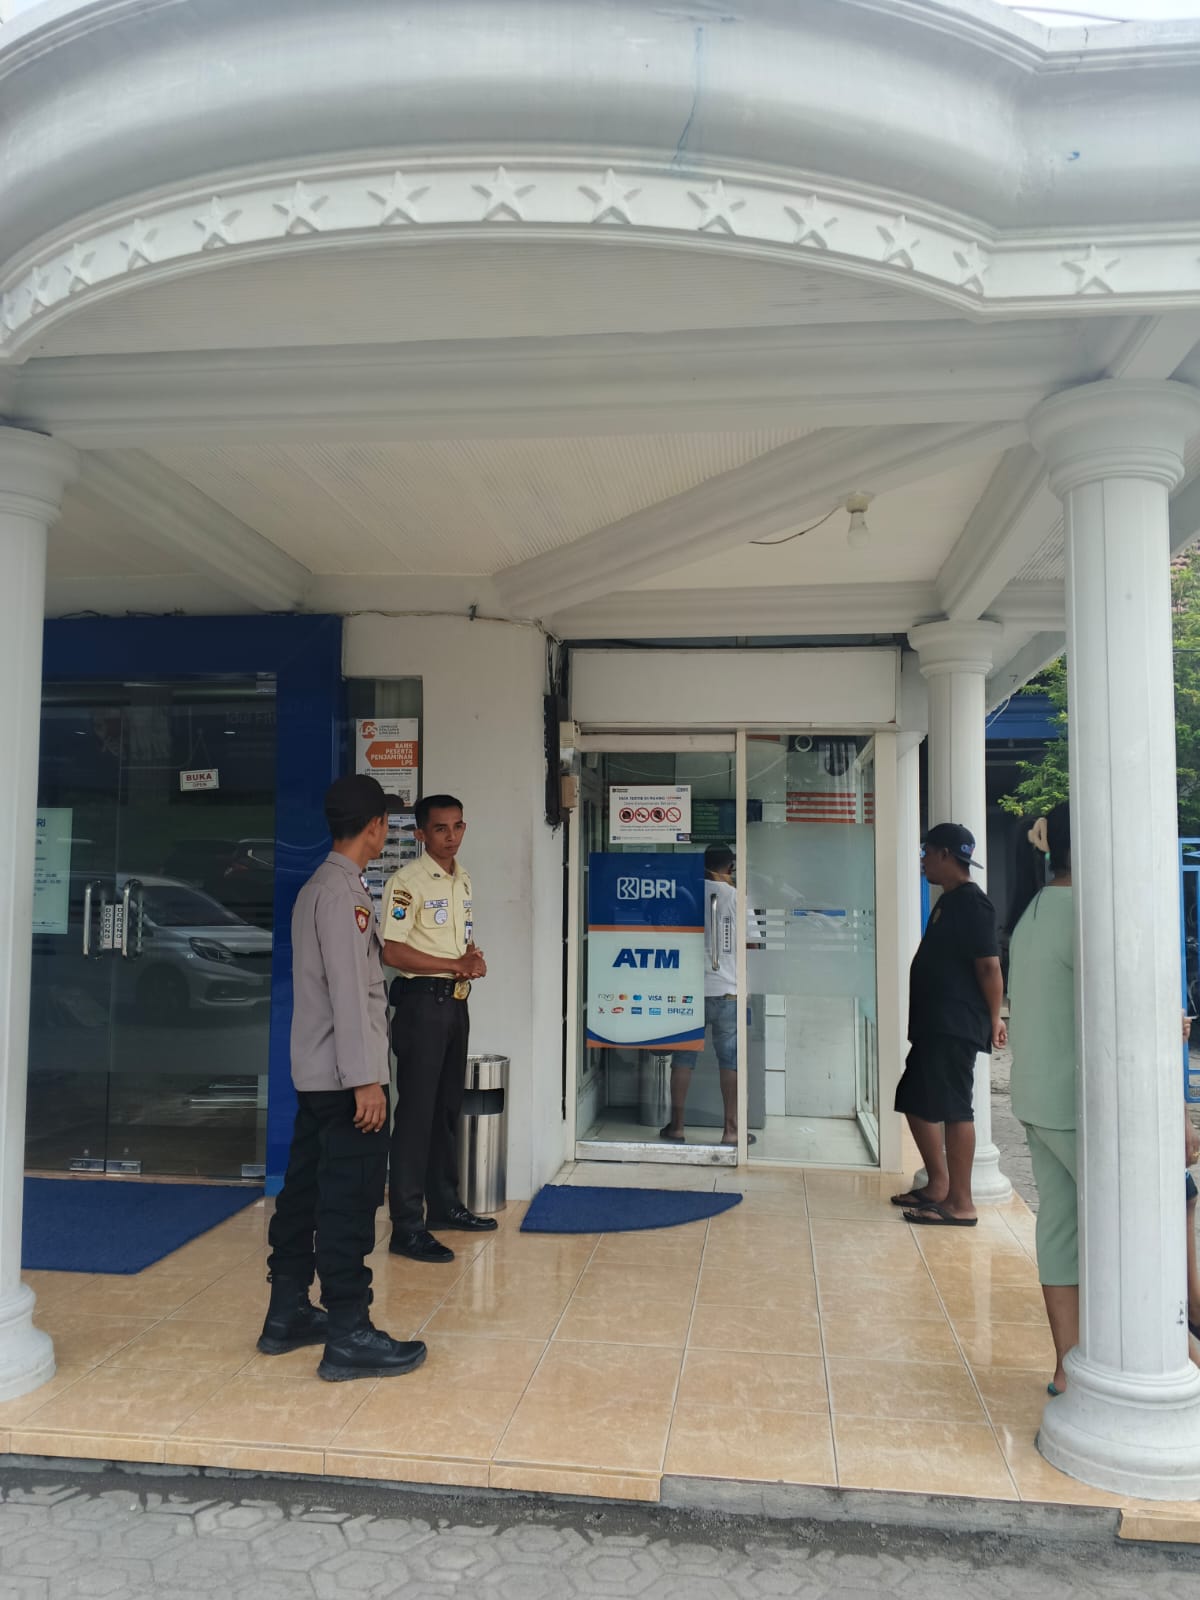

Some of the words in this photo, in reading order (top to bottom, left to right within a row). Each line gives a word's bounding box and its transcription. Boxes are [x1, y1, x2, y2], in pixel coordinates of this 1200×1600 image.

[186, 773, 212, 781] BUKA
[36, 817, 46, 828] RI
[641, 879, 677, 899] BRI
[104, 907, 112, 939] DORONG
[612, 948, 680, 968] ATM
